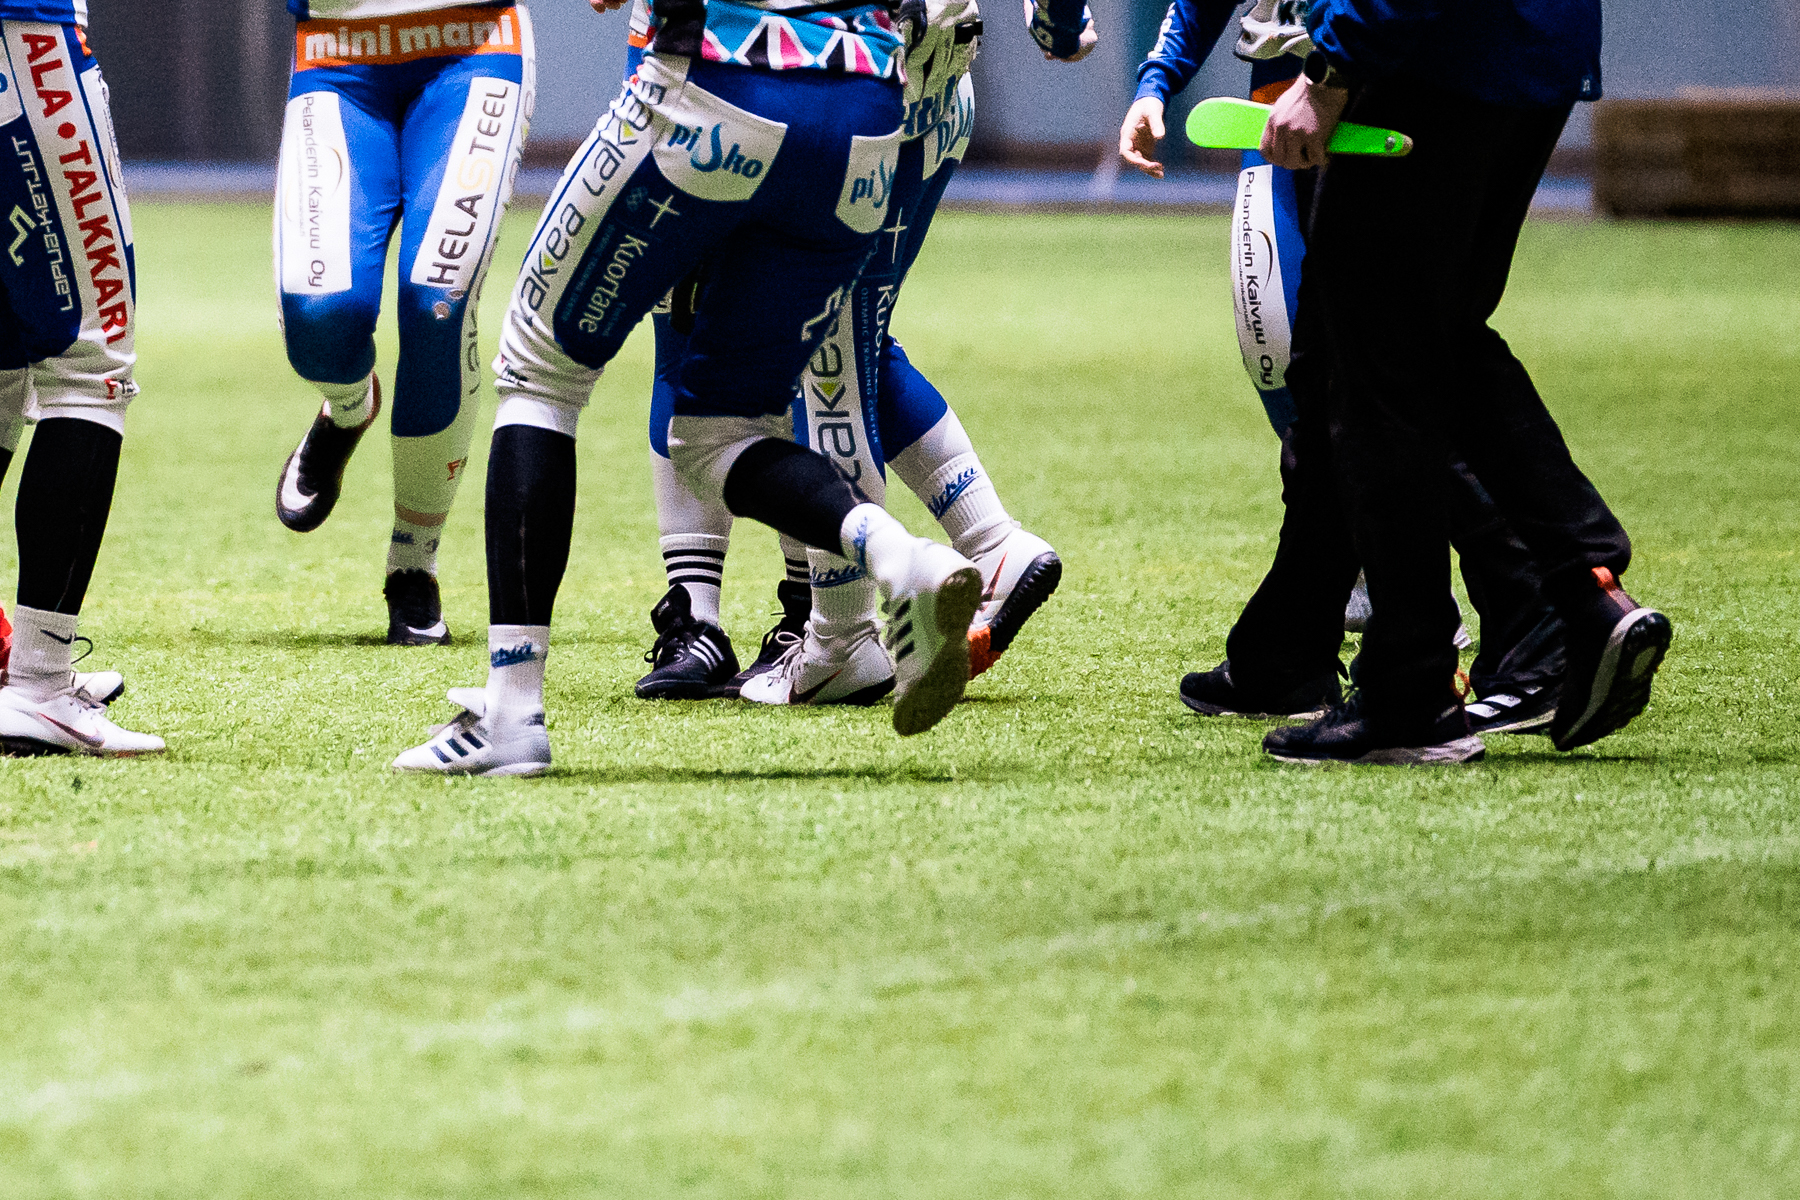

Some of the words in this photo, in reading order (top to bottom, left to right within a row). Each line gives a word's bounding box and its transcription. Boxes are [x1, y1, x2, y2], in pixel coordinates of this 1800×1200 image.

[304, 23, 392, 61] mini
[398, 14, 514, 54] mani
[20, 32, 73, 119] ALA
[58, 139, 127, 345] TALKKARI
[308, 186, 323, 249] Kaivuu
[1242, 171, 1255, 268] Pelanderin
[308, 259, 326, 288] Oy
[520, 203, 586, 311] akea
[578, 234, 649, 335] Kuortane
[1246, 274, 1267, 346] Kaivuu
[1259, 354, 1274, 386] Oy
